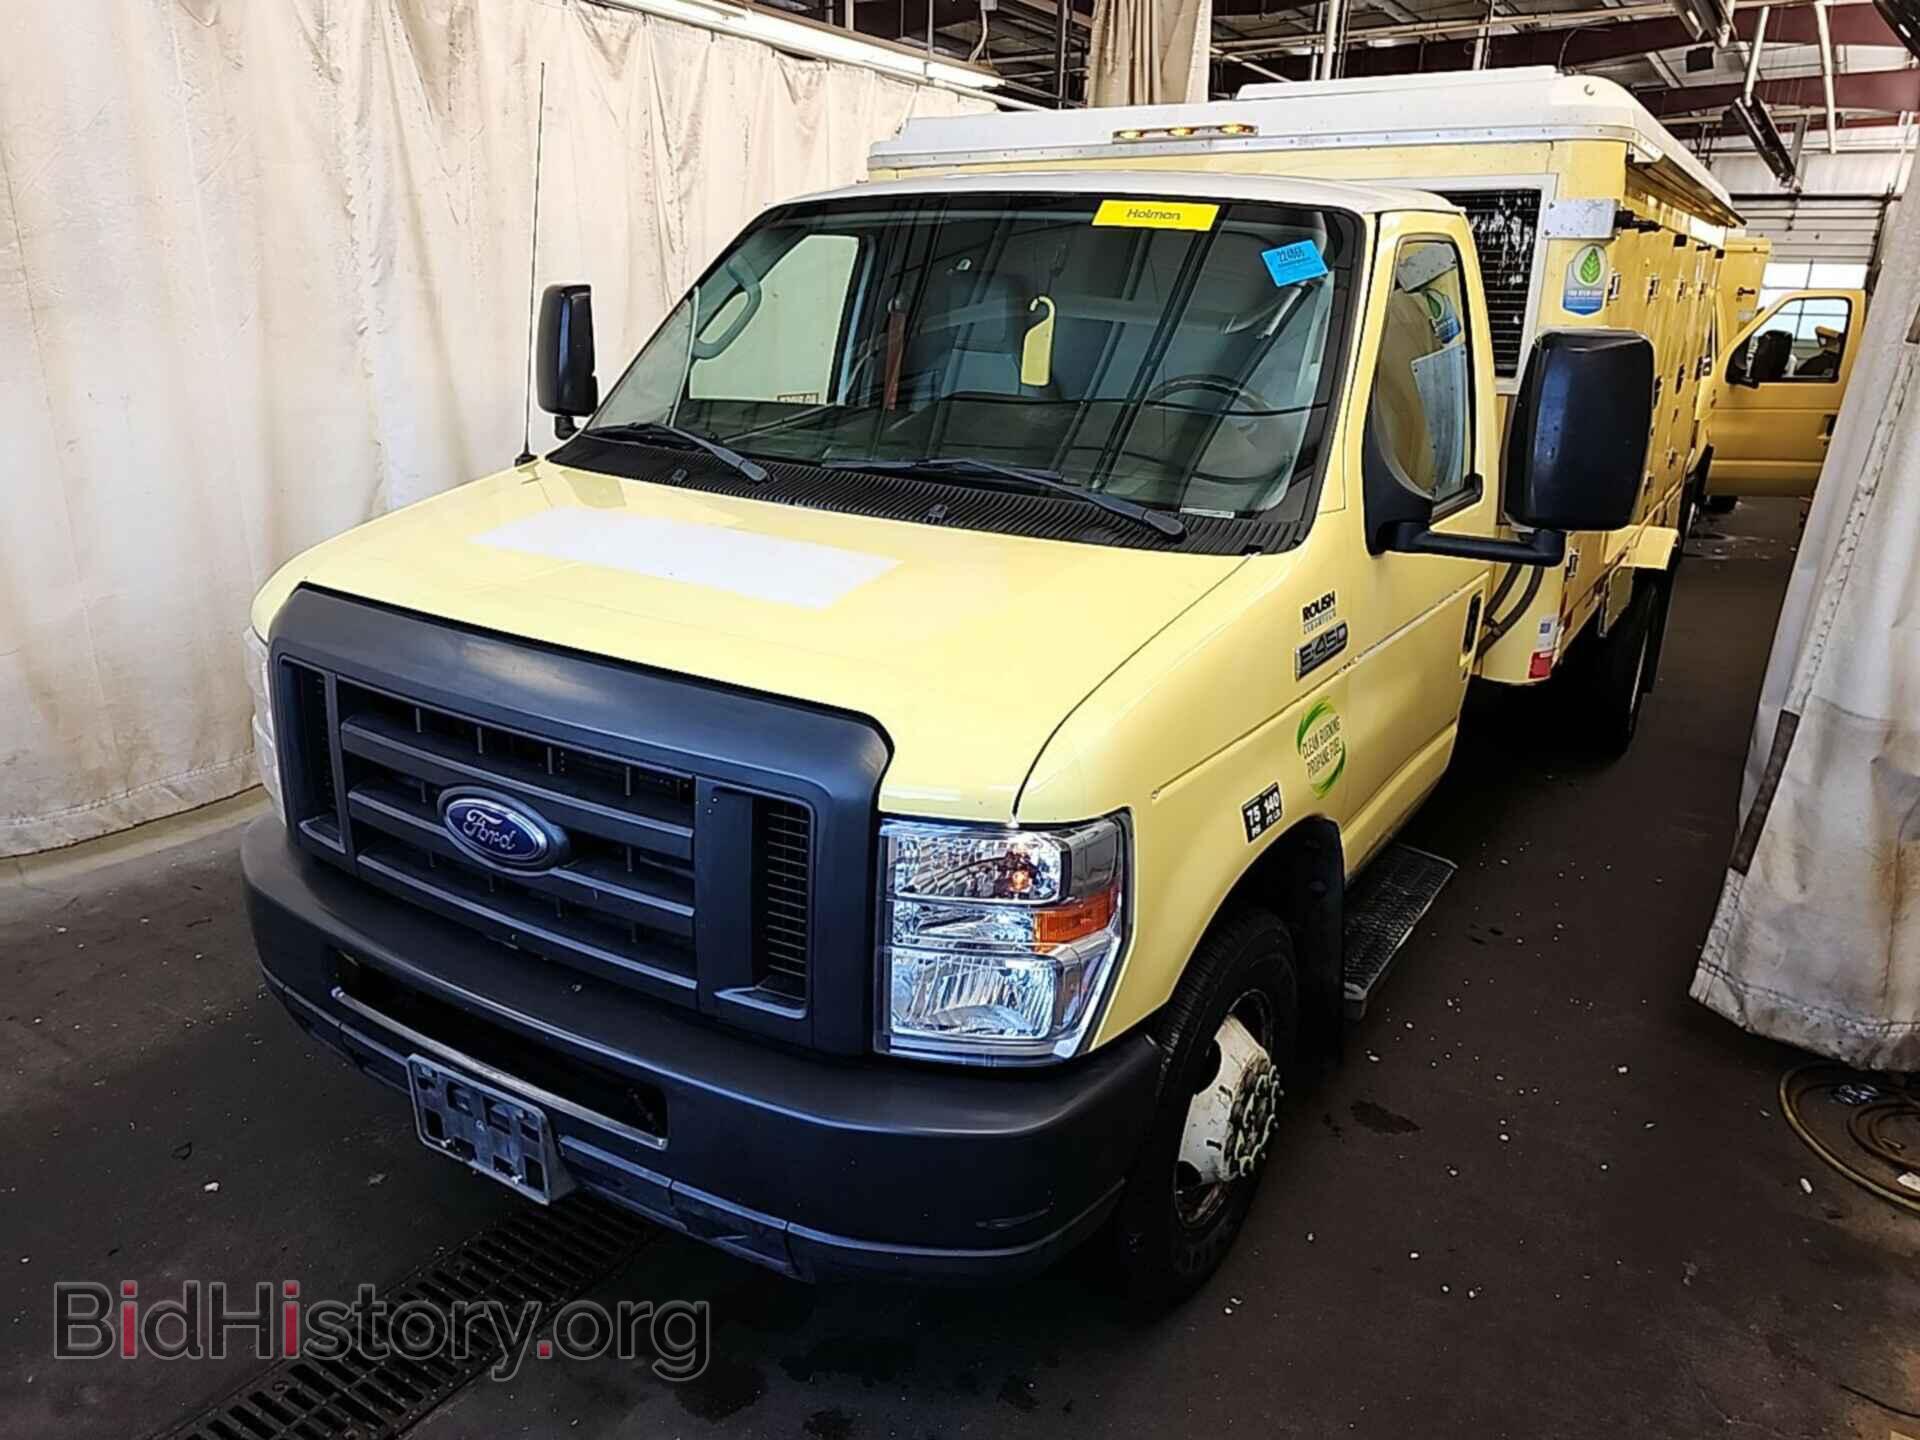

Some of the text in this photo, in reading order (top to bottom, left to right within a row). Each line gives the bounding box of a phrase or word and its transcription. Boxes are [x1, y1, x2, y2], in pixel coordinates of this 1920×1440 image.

[1126, 207, 1182, 221] Holman
[1302, 590, 1336, 623] ROUSH
[1246, 804, 1261, 826] 75
[462, 808, 517, 851] Ford
